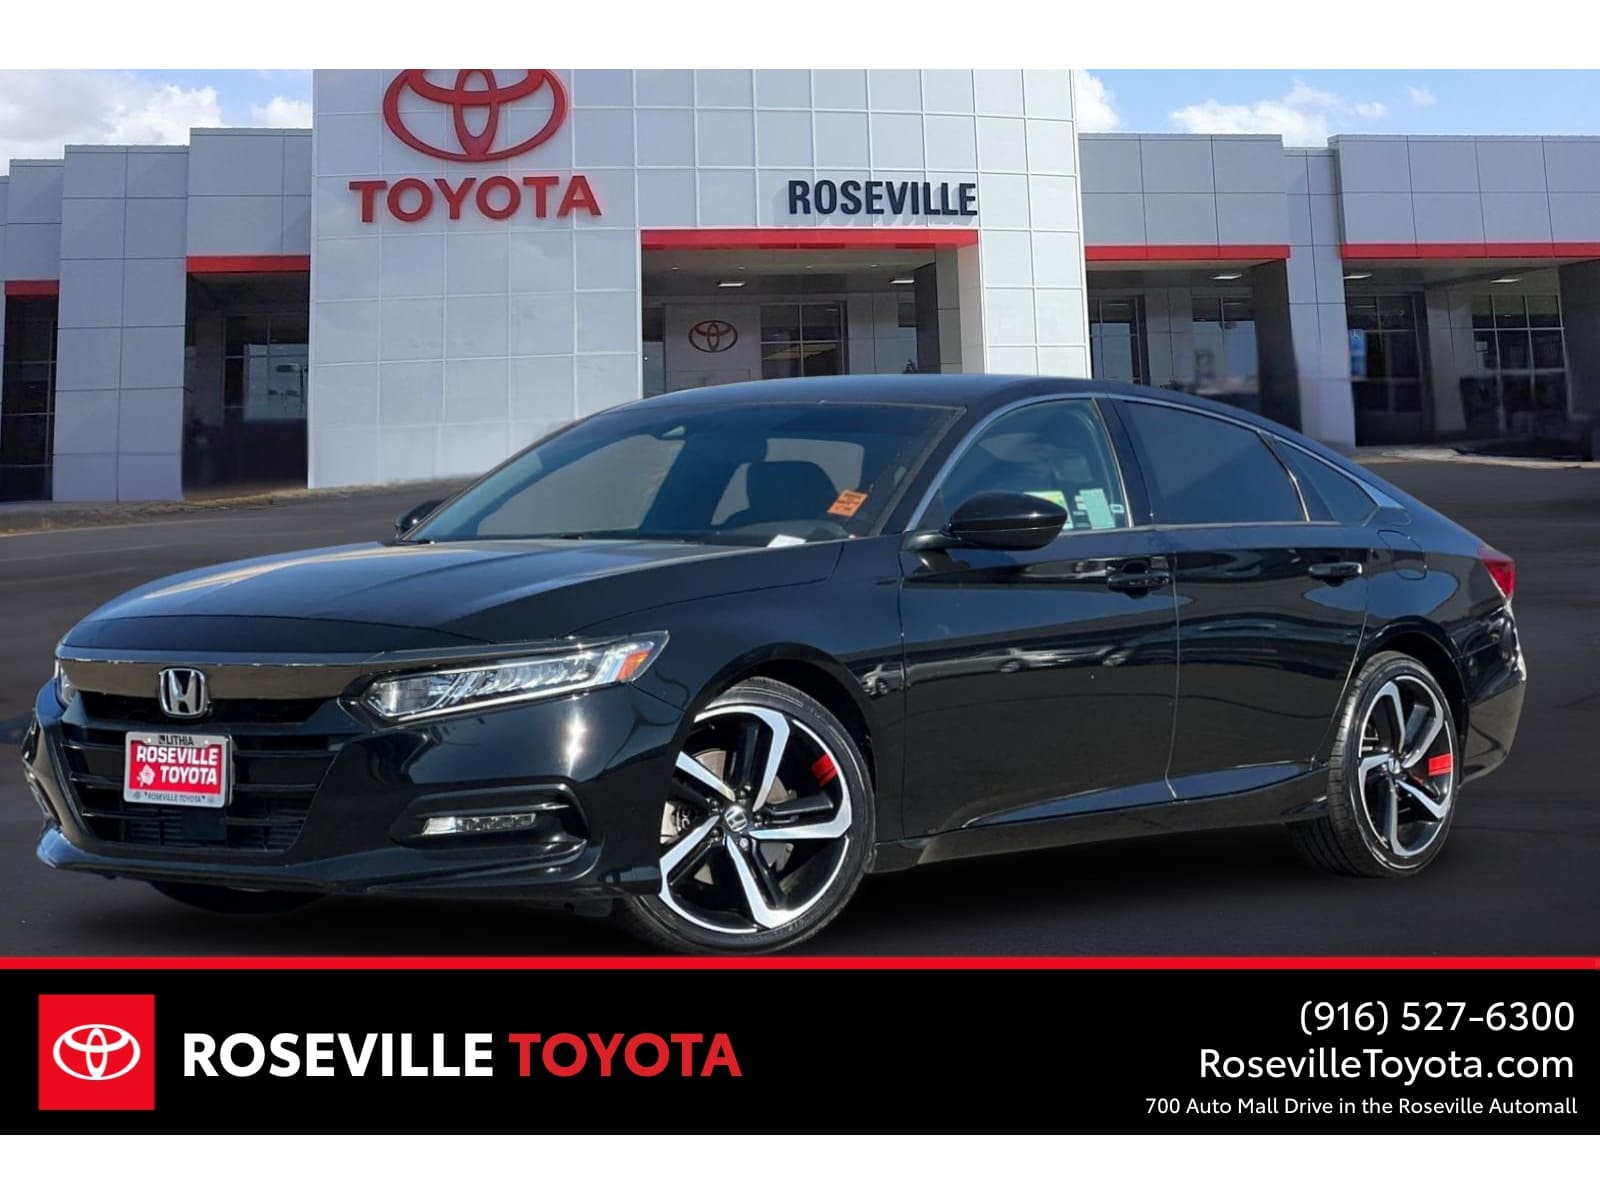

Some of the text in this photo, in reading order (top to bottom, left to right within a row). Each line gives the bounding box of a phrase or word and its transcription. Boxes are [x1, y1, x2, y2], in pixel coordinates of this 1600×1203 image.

[350, 175, 602, 222] TOYOTA
[788, 180, 979, 217] ROSEVILLE
[166, 735, 194, 746] LITHIA
[136, 745, 219, 766] ROSEVILLE
[160, 765, 218, 785] TOYOTA
